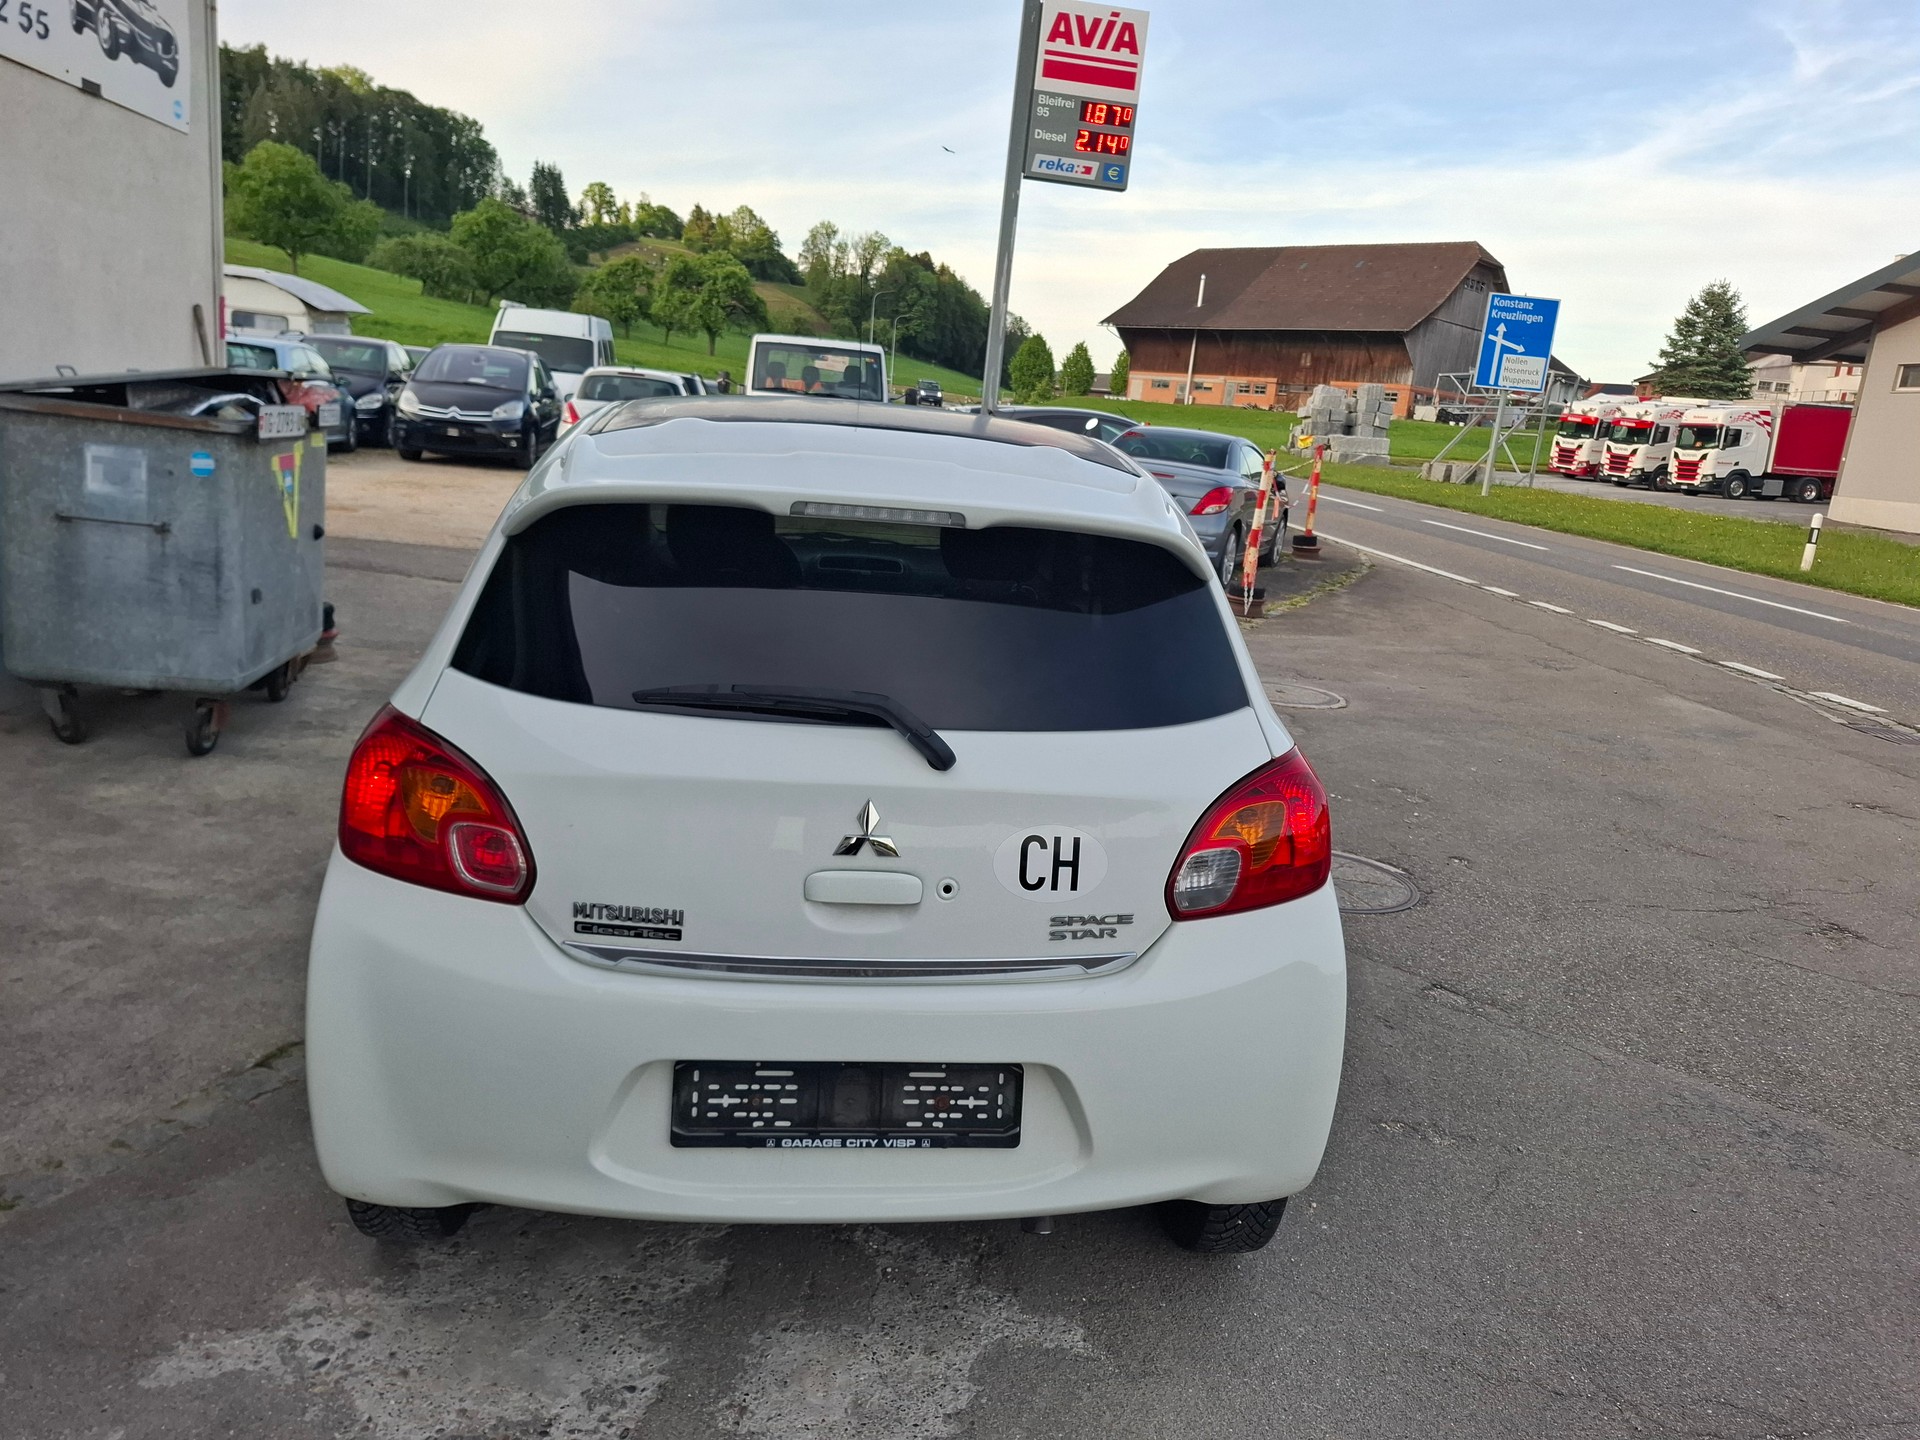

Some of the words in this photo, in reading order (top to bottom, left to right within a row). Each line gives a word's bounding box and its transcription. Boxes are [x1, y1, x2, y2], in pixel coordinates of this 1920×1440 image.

[18, 1, 50, 40] 55
[1037, 94, 1076, 109] Bleifrei
[1036, 106, 1050, 118] 95
[1034, 129, 1067, 143] Diesel
[1493, 296, 1535, 310] Konstanz
[1491, 308, 1544, 324] Kreuzlingen
[1504, 356, 1528, 366] Nollen
[1503, 367, 1540, 377] Hosenruck
[1502, 375, 1539, 386] Wuppenau
[1018, 834, 1081, 892] CH
[572, 901, 685, 927] MITSUBISHI
[1048, 913, 1135, 928] SPACE
[575, 923, 681, 940] ClearTec
[1048, 927, 1118, 941] STAR
[781, 1138, 843, 1148] GARAGE
[846, 1138, 878, 1148] CITY
[883, 1138, 917, 1148] VISP
